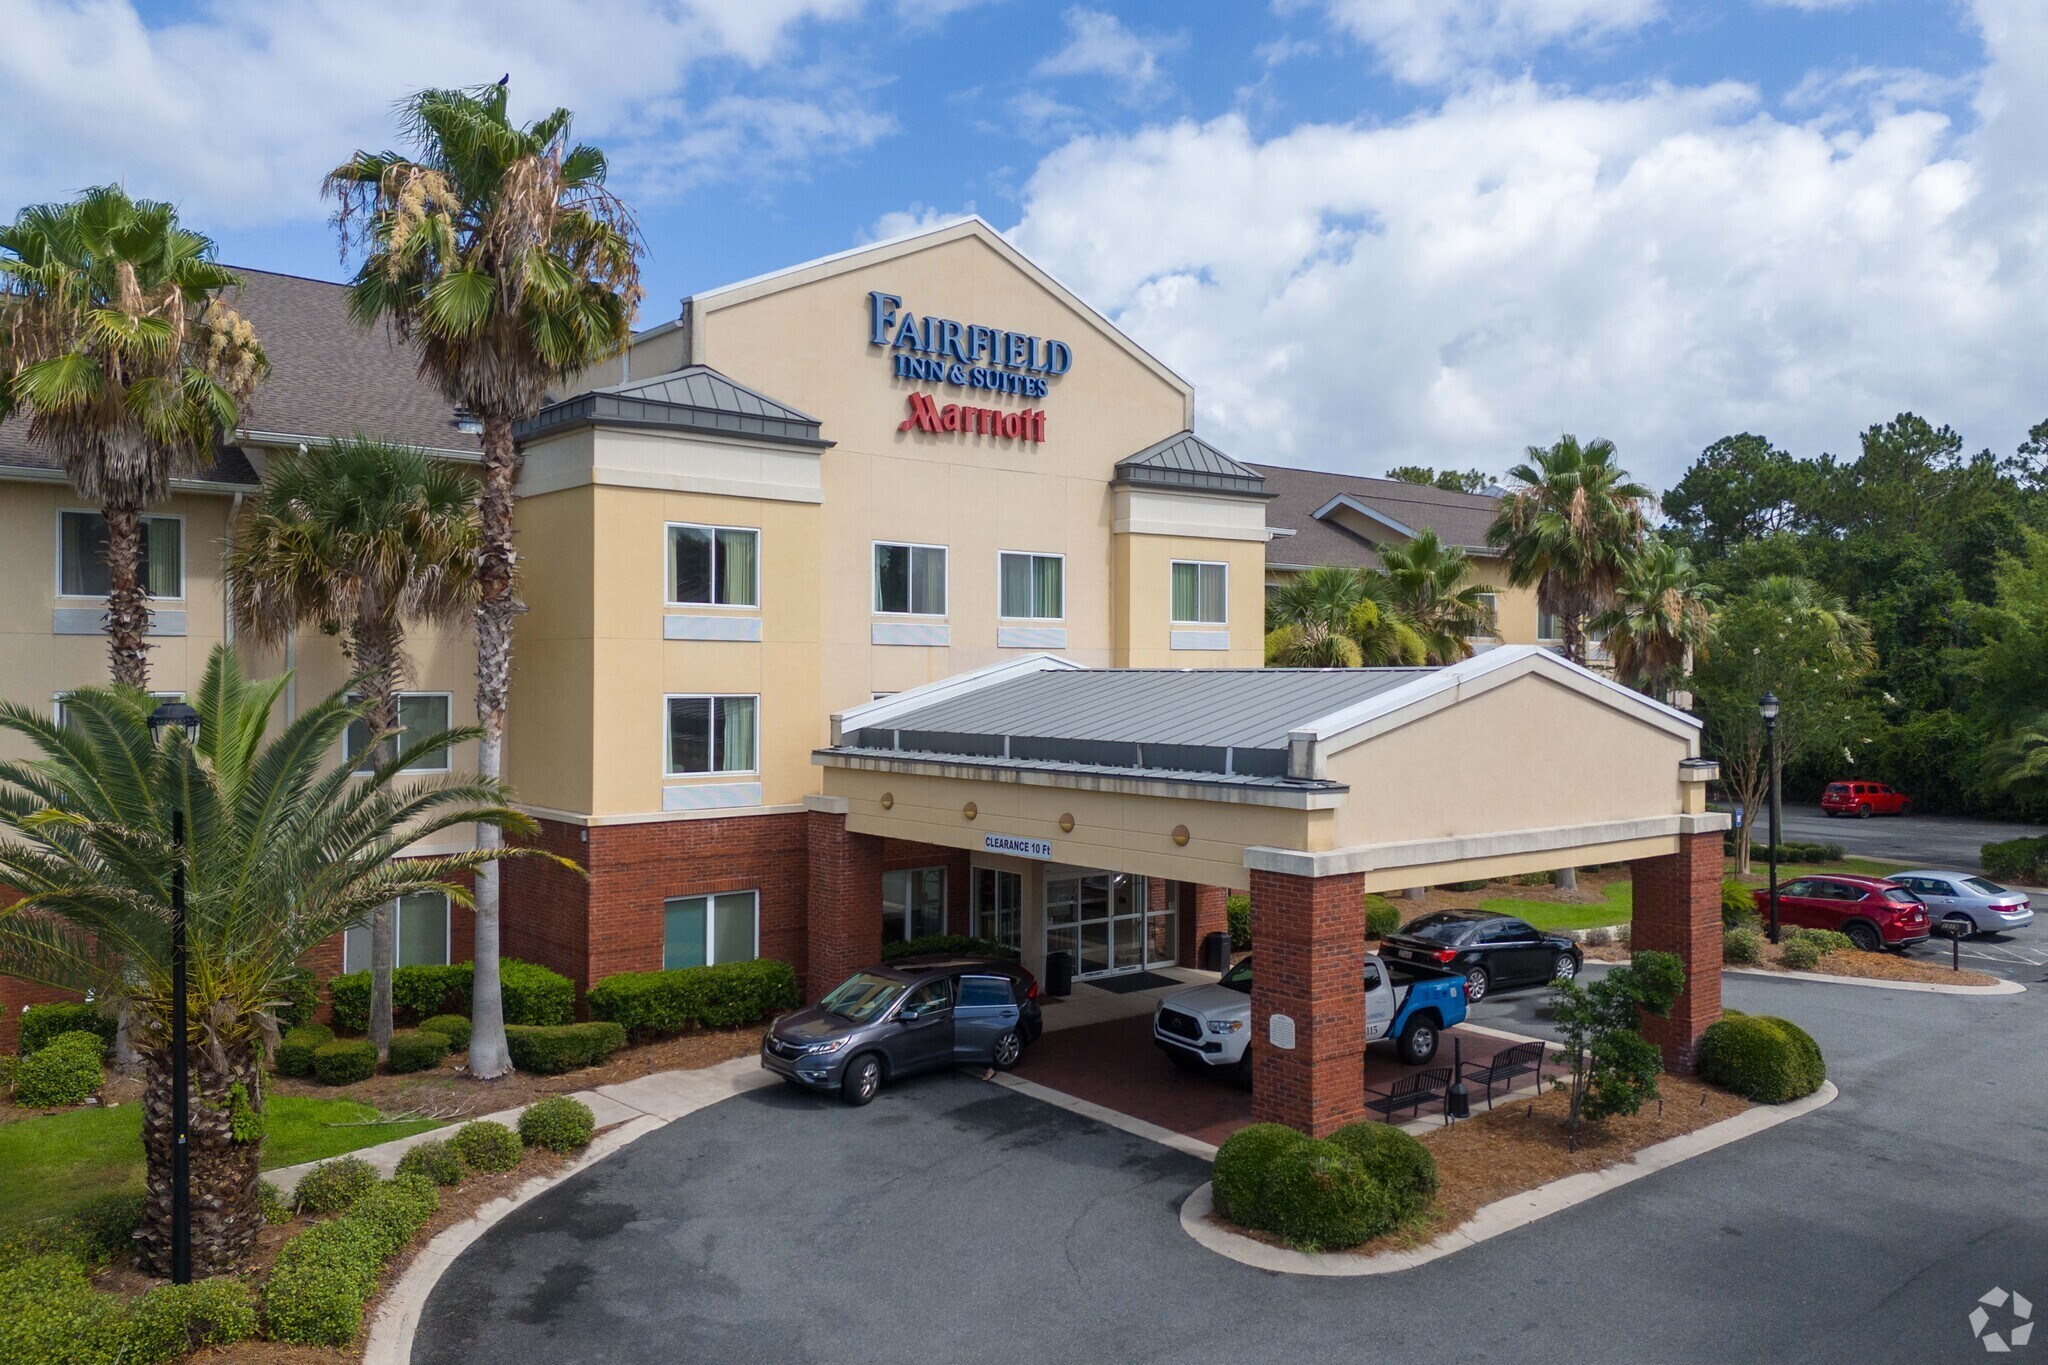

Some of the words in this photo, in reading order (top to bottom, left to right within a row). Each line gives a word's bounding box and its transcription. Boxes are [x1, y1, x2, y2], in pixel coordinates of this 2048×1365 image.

[868, 291, 1072, 375] FAIRFIELD
[894, 353, 946, 382] INN
[947, 362, 970, 386] &
[969, 366, 1049, 398] SUITES
[897, 391, 1047, 443] Marriott
[985, 837, 1029, 852] CLEARANCE
[1031, 843, 1040, 853] 10
[1042, 844, 1050, 855] Ft
